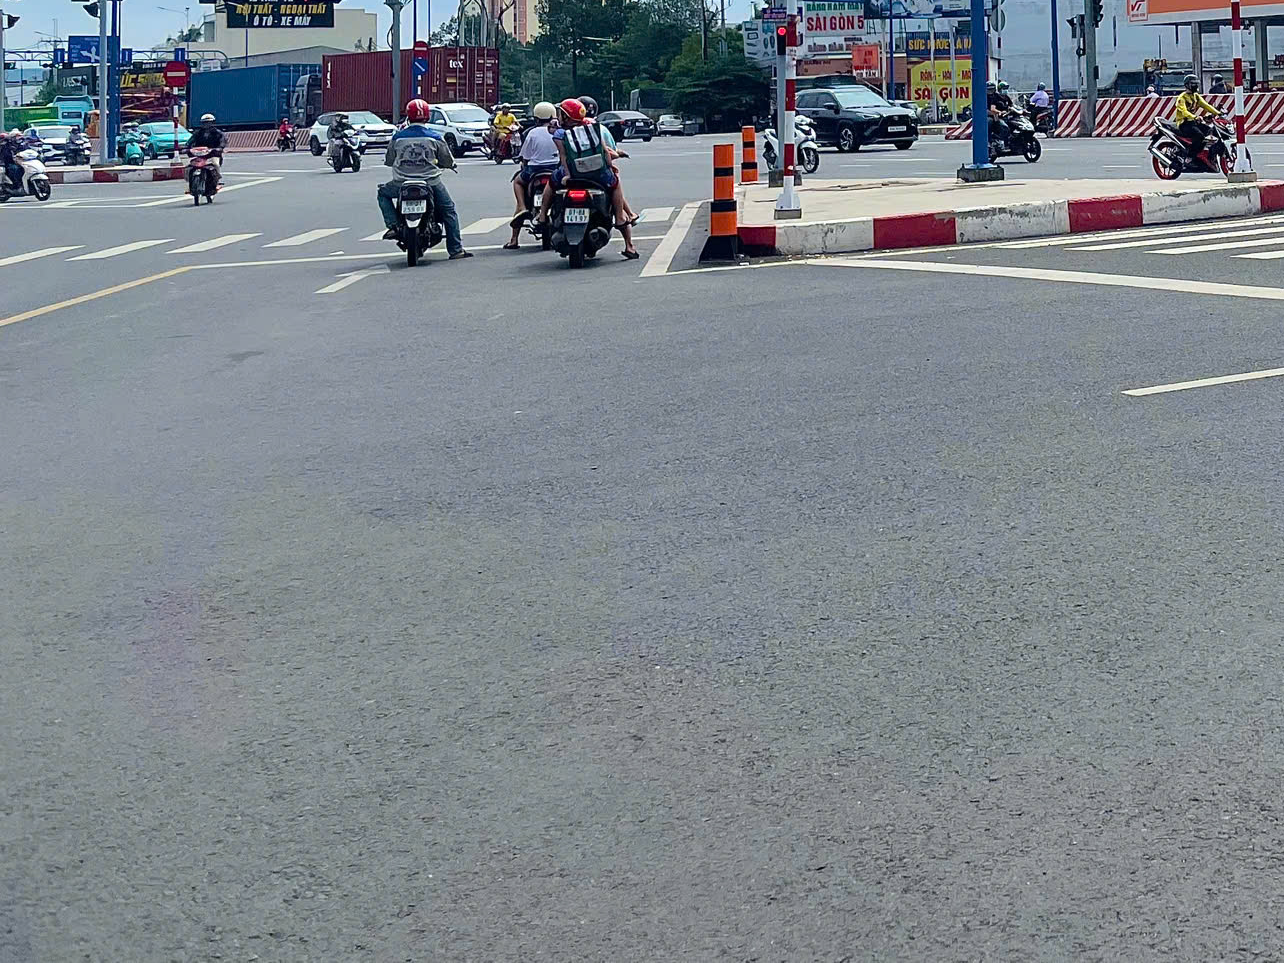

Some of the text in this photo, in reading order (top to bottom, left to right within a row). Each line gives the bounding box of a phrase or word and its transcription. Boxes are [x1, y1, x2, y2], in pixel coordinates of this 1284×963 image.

[281, 16, 293, 26] XE
[807, 13, 827, 32] SÀI
[830, 12, 854, 30] GÒN
[857, 15, 864, 29] 5
[449, 59, 464, 68] tex
